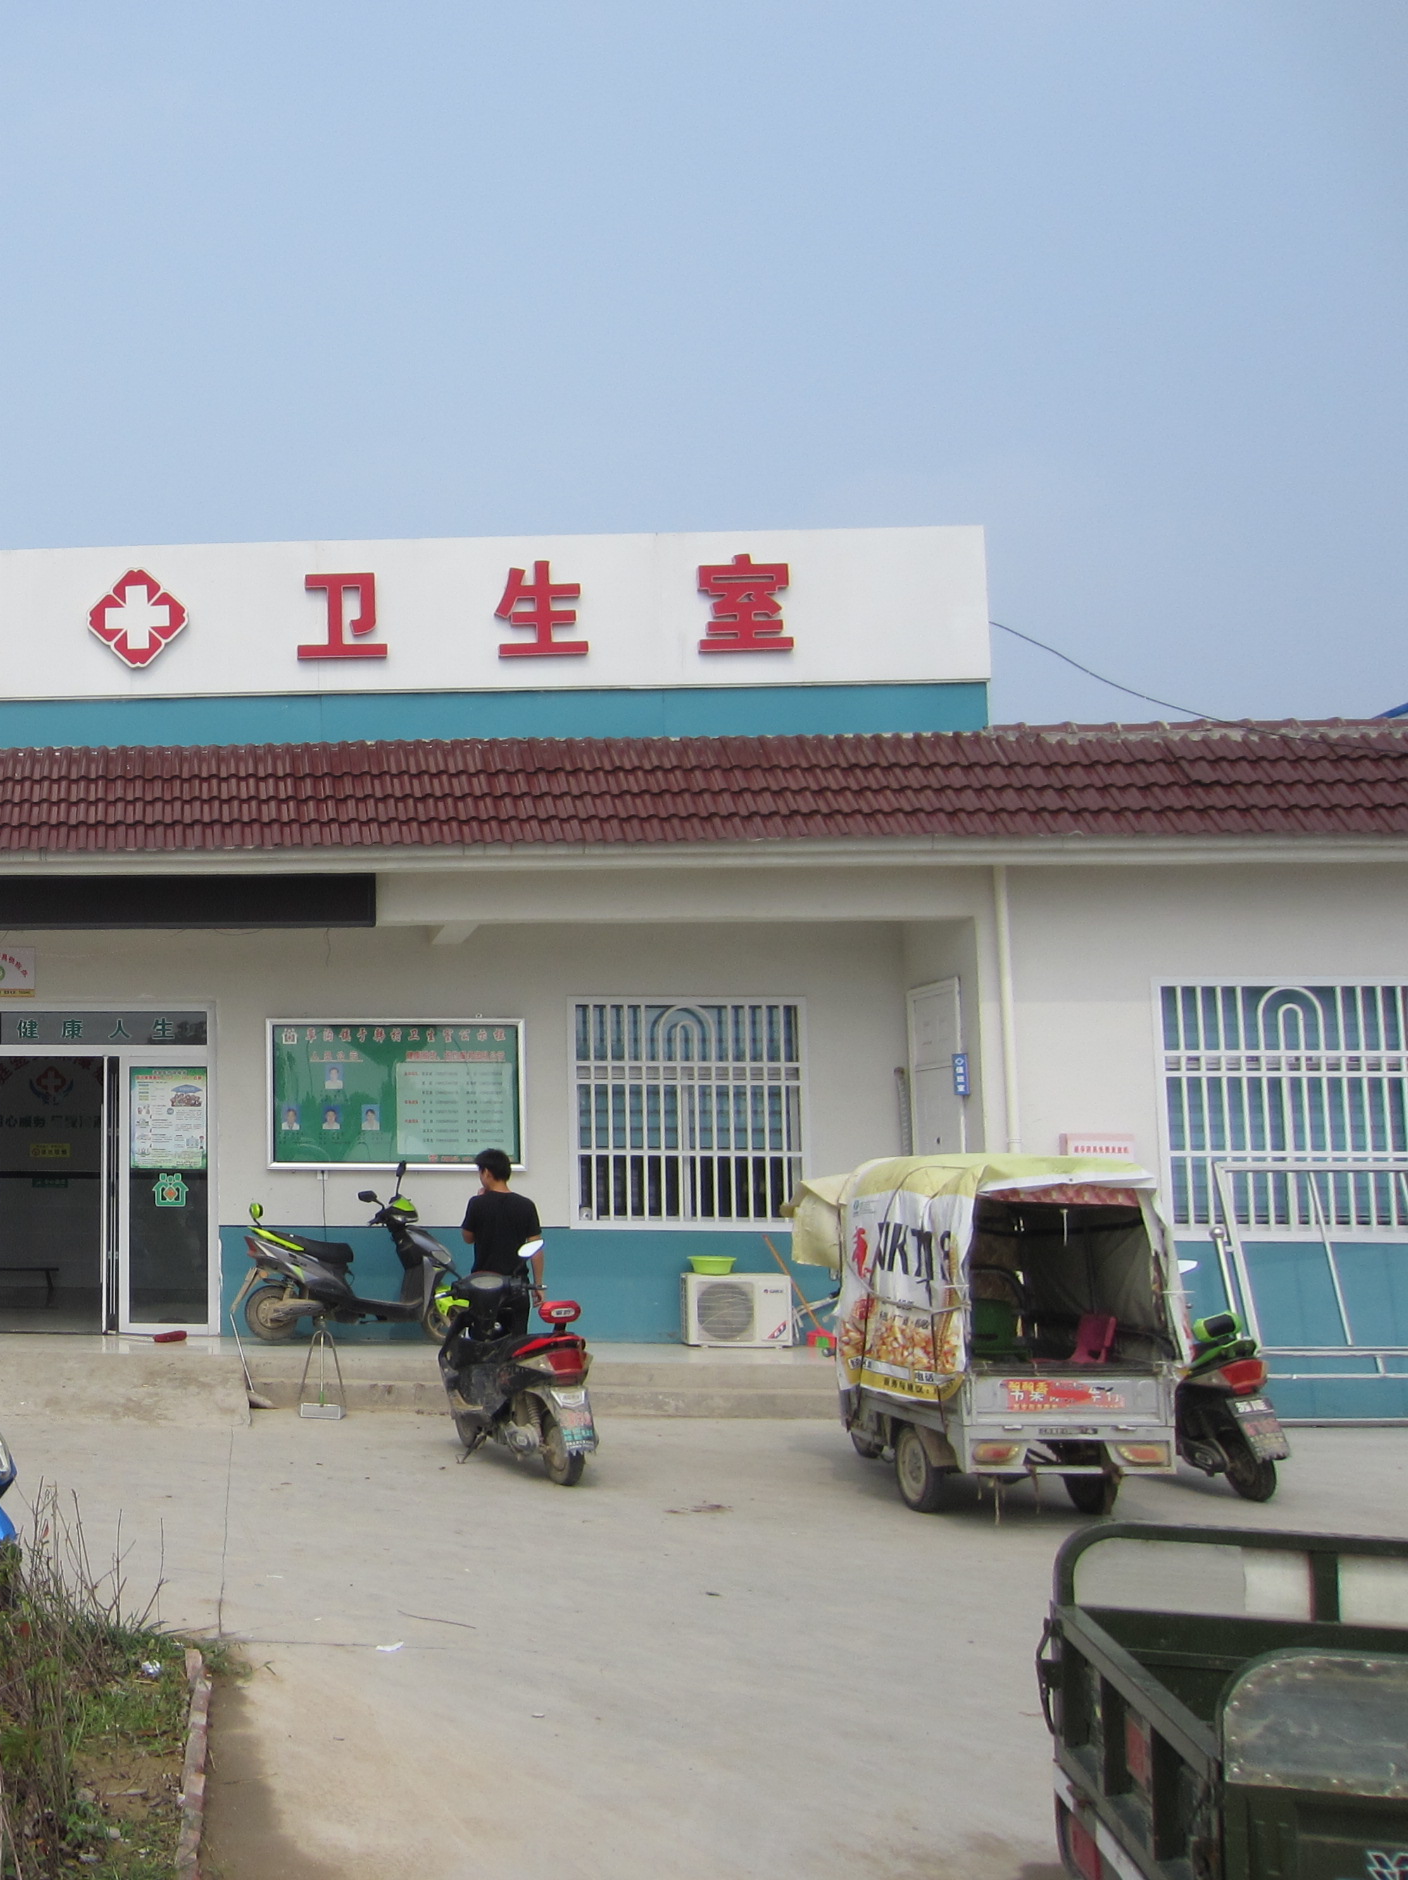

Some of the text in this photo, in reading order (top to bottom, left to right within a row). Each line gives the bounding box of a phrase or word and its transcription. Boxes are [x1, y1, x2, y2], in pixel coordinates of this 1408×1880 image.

[297, 553, 794, 660] 卫生室
[16, 1017, 176, 1040] 健康人生
[304, 1027, 507, 1043] 草沟镇于韩村卫生室公示栏
[916, 1370, 935, 1382] 电话
